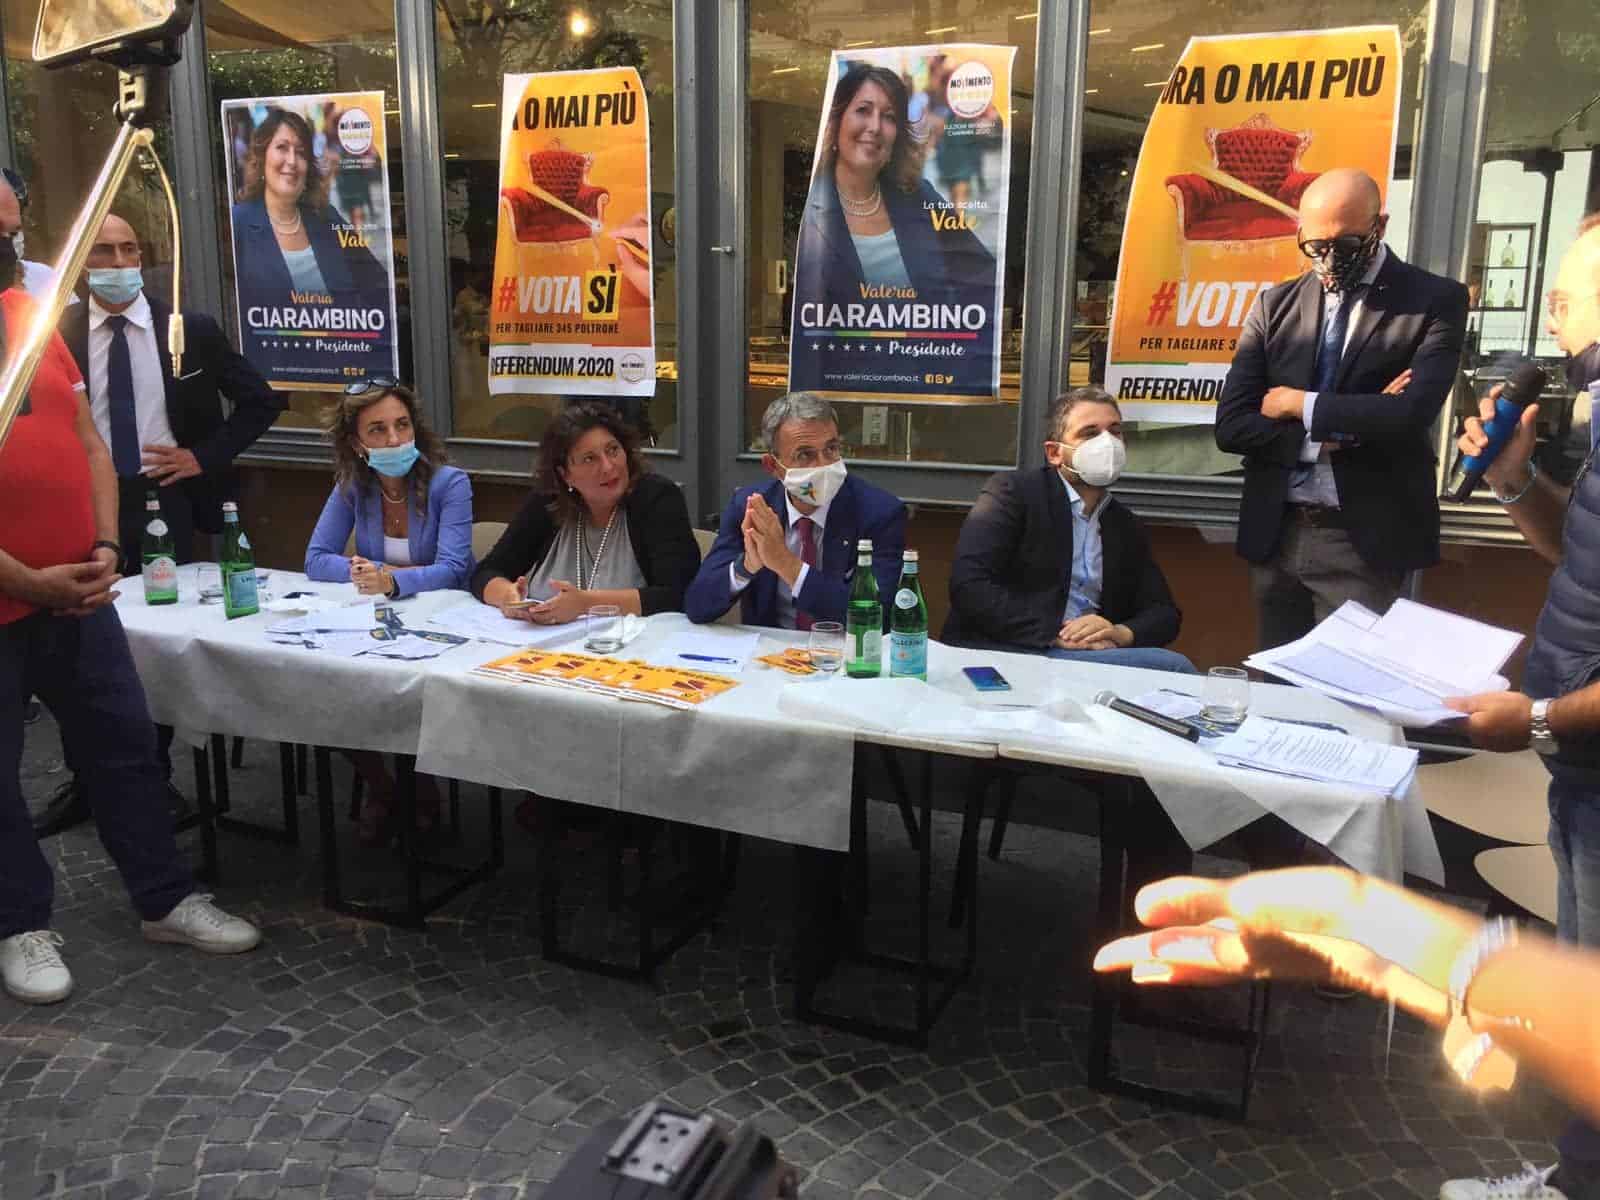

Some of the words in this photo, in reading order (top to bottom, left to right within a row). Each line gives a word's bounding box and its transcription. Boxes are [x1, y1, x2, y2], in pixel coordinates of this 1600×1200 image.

[1214, 64, 1241, 104] O
[1245, 60, 1315, 103] MAI
[1319, 43, 1386, 100] PIÙ
[525, 98, 540, 130] O
[545, 95, 589, 129] MAI
[594, 81, 636, 127] PIÙ
[930, 209, 978, 232] Vale
[499, 275, 582, 314] #VOTA
[588, 264, 617, 314] SÌ
[858, 281, 918, 299] Valeria
[247, 306, 385, 330] CIARAMBINO
[801, 303, 987, 330] CIARAMBINO
[496, 322, 512, 334] PER
[514, 322, 553, 334] TAGLIARE
[574, 323, 620, 334] POLTRONE
[315, 339, 373, 353] Presidente
[888, 340, 966, 357] Presidente
[1139, 337, 1162, 350] PER
[1167, 338, 1225, 350] TAGLIARE
[577, 356, 615, 377] 2020
